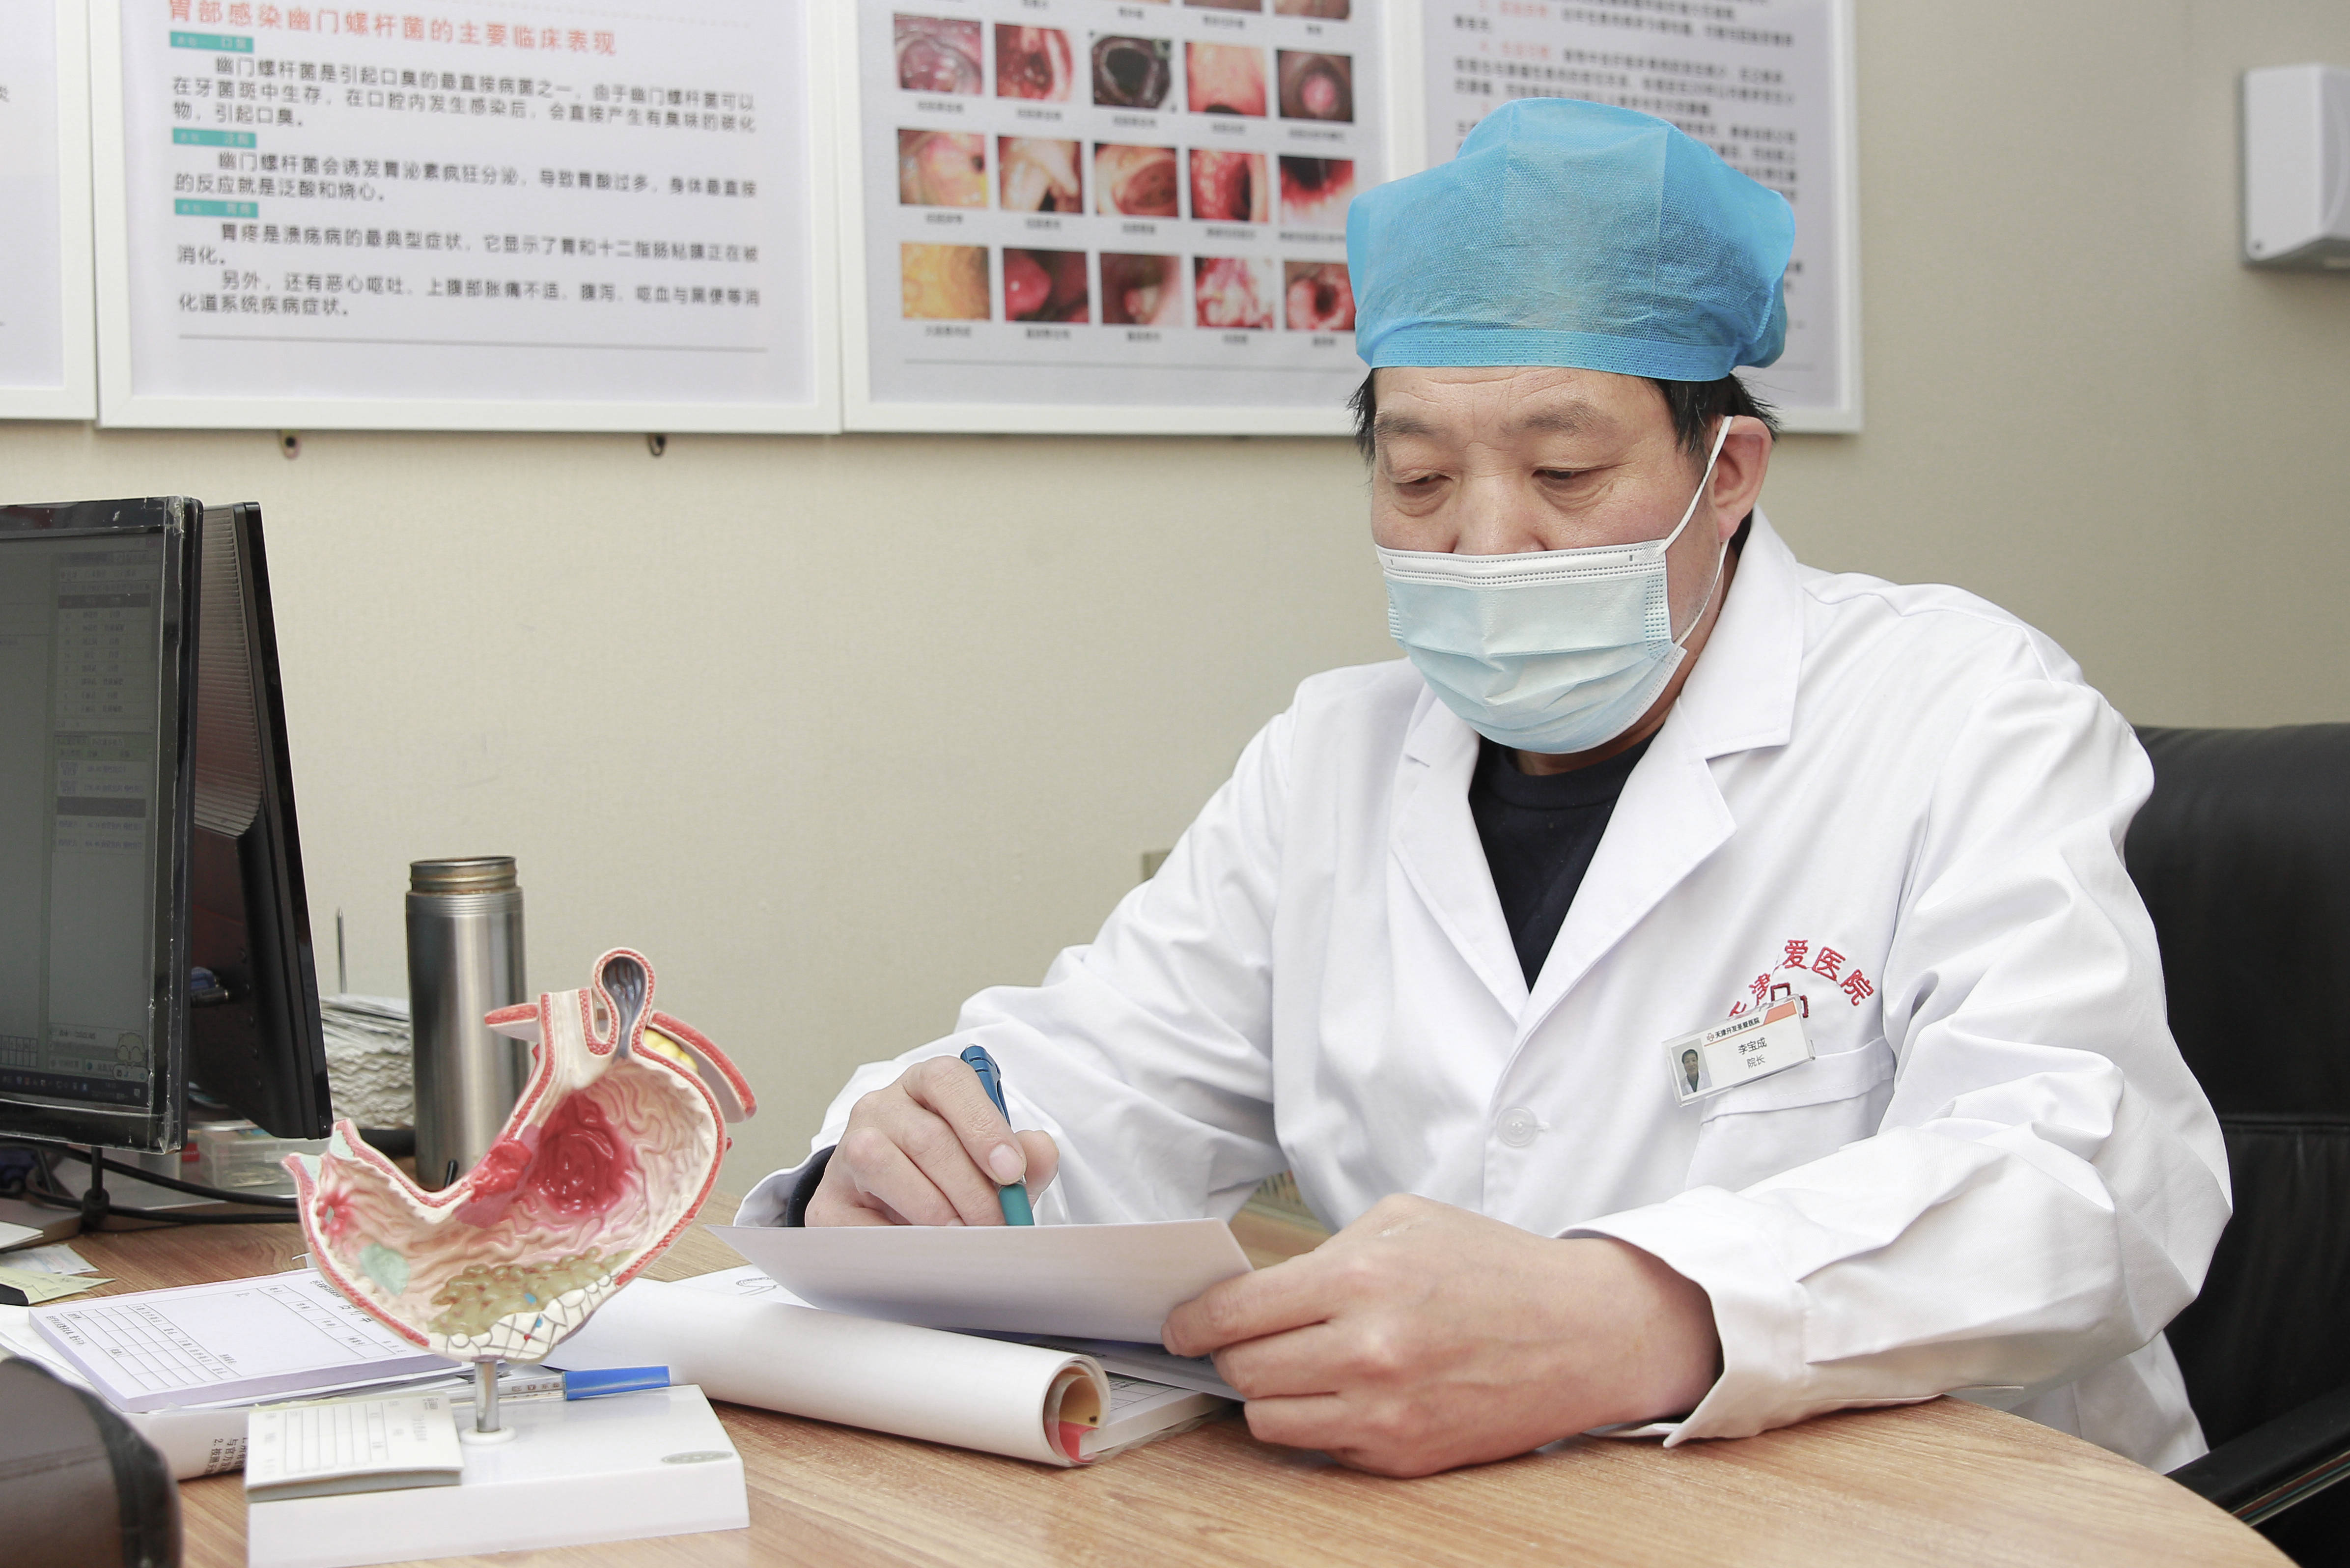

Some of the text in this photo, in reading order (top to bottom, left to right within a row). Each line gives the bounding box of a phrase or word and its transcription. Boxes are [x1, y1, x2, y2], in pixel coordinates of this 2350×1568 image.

[170, 0, 616, 56] 胃部感染幽门螺杆菌的主要临床表现
[1737, 1036, 1767, 1055] 李宝成
[1746, 1054, 1765, 1068] 院长
